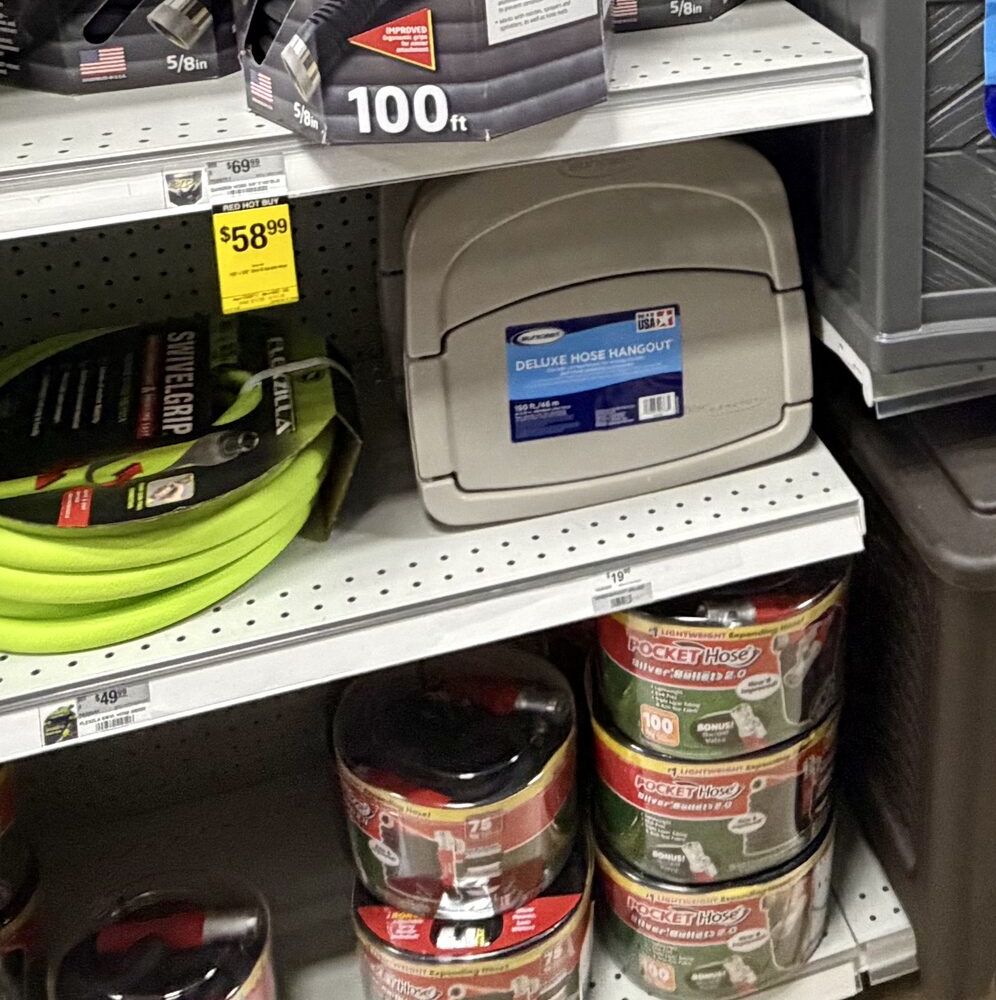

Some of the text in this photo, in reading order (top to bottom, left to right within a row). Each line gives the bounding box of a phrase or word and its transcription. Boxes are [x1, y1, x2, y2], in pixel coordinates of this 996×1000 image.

[670, 0, 702, 17] 5/8in
[385, 26, 427, 35] IMPROVED
[166, 54, 208, 72] 5/8in
[293, 100, 319, 130] 5/8in
[223, 198, 279, 212] RED HOT BUY
[220, 218, 287, 253] $5899
[638, 319, 655, 330] USA
[515, 339, 673, 371] DELUXE HOSE HANGOUT
[161, 331, 196, 436] SWIVELGRIP
[660, 629, 728, 639] LIGHTWEIGHT
[628, 637, 750, 666] POCKET Hose
[642, 711, 673, 734] 100
[697, 721, 734, 732] BONUS!
[635, 776, 736, 799] POCKET Hose
[467, 819, 492, 832] 75
[627, 896, 742, 926] POCKET Hose
